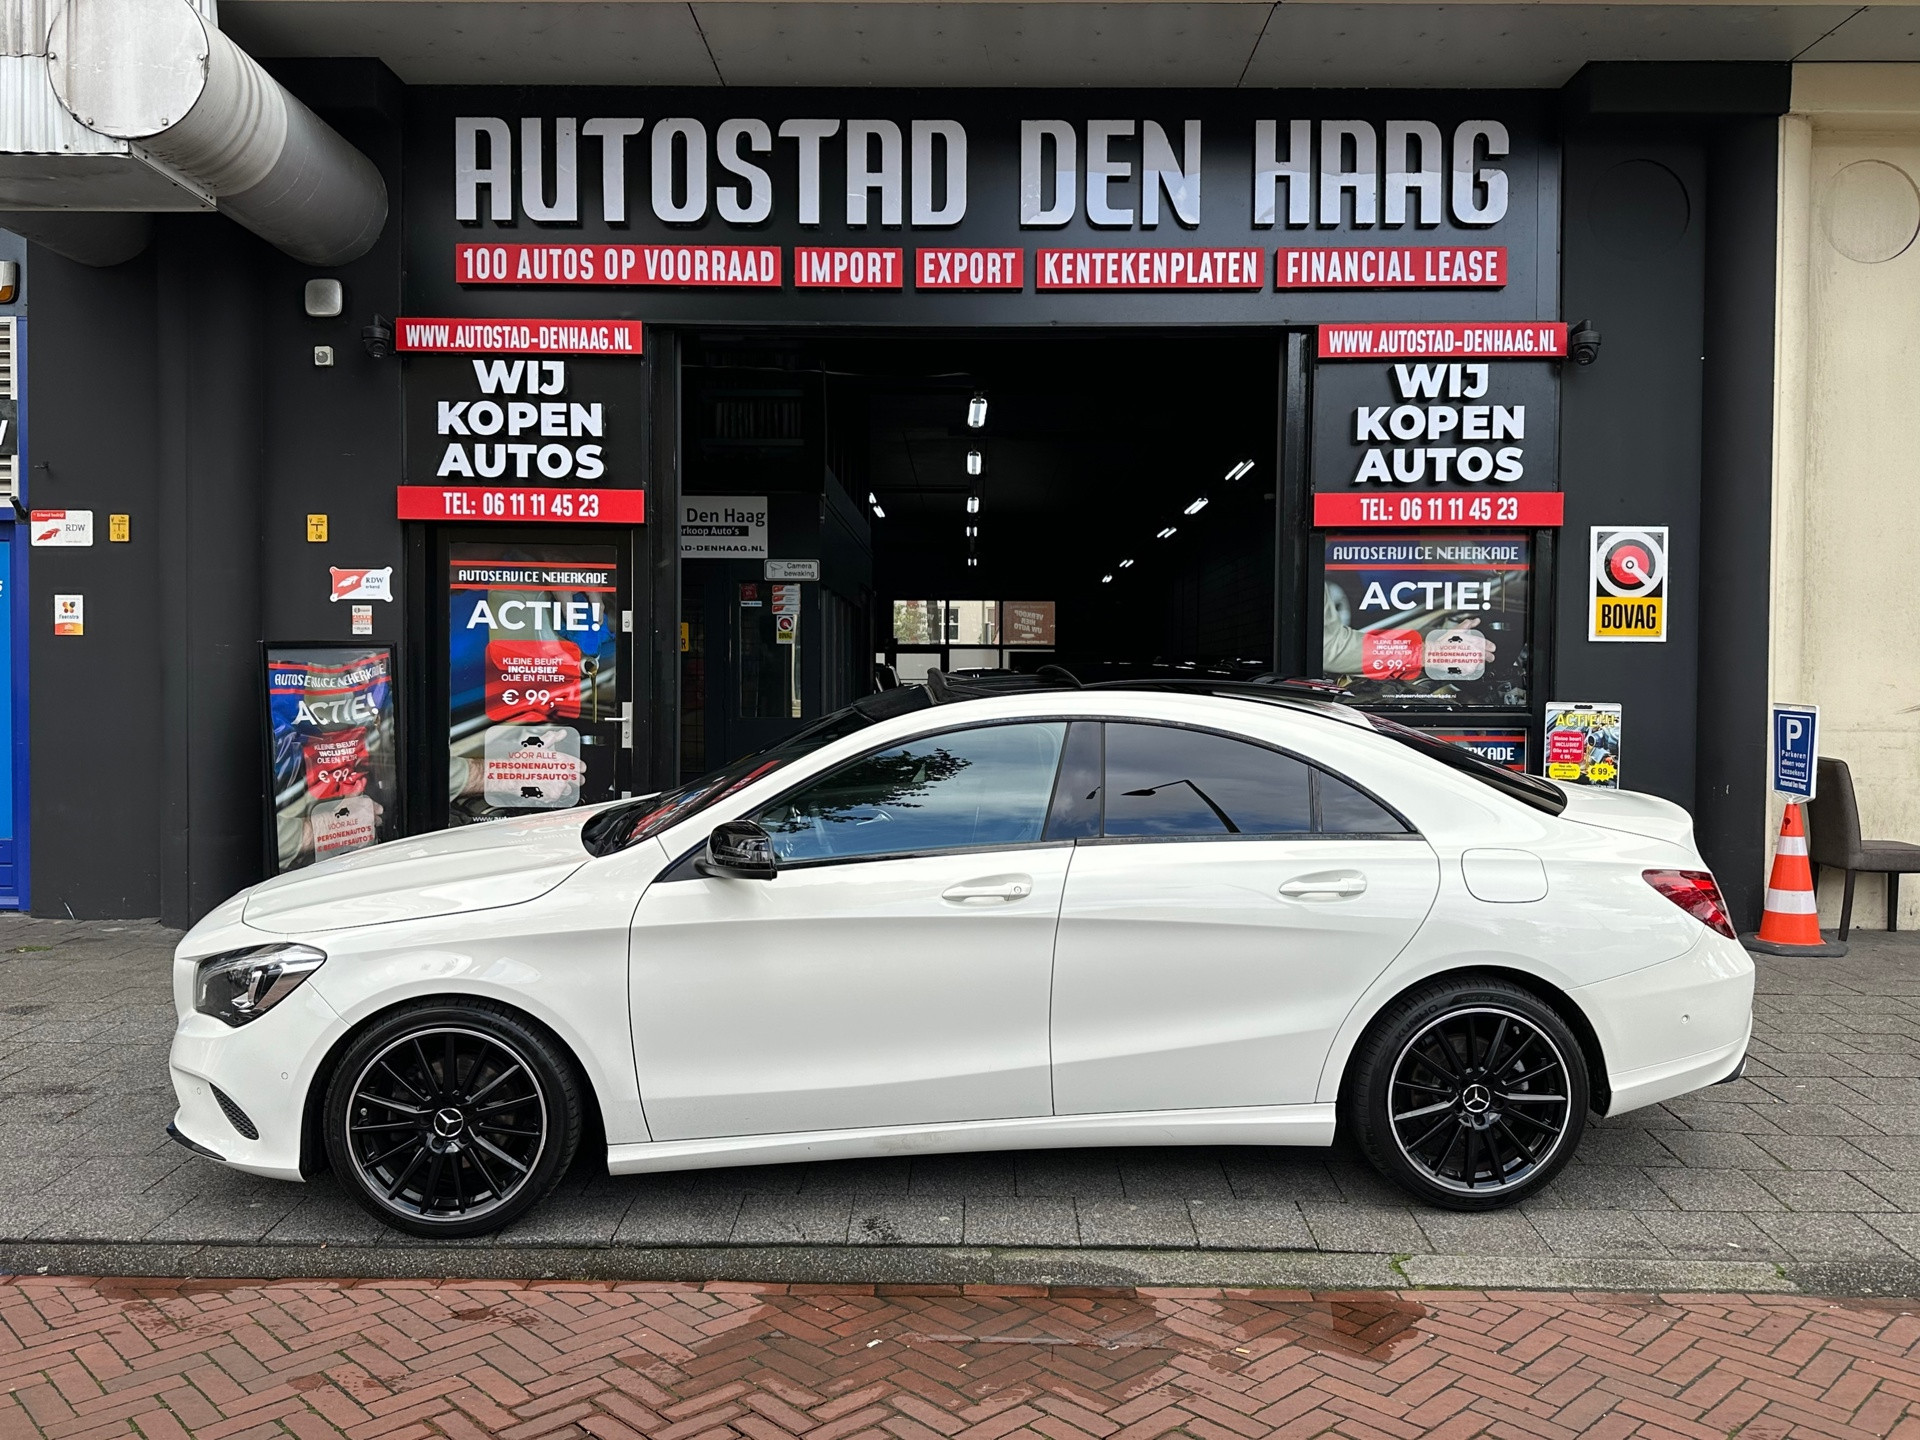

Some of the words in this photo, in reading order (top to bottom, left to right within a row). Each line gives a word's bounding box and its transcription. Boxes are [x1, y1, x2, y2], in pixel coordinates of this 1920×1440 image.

[455, 117, 967, 225] AUTOSTAD
[1020, 119, 1202, 225] DEN
[1254, 119, 1510, 225] HAAG
[463, 248, 507, 280] 100
[517, 248, 595, 281] AUTOS
[604, 249, 635, 281] OP
[644, 249, 775, 282] VOORRAAD
[801, 251, 896, 283] IMPORT
[923, 251, 1016, 284] EXPORT
[1044, 251, 1258, 285] KENTEKENPLATEN
[1287, 250, 1415, 283] FINANCIAL
[1425, 250, 1498, 282] LEASE
[406, 324, 632, 350] WWW.AUTOSTAD-DENHAAG.NL
[1328, 329, 1557, 353] WWW.AUTOSTAD-DENHAAG.NL
[472, 359, 565, 395] WIJ
[1394, 363, 1489, 398] WIJ
[437, 400, 604, 437] KOPEN
[1356, 404, 1525, 441] KOPEN
[436, 443, 605, 480] AUTOS
[1354, 446, 1524, 483] AUTOS
[443, 492, 476, 515] TEL:
[482, 492, 505, 516] 06
[510, 493, 525, 516] 11
[530, 494, 545, 516] 11
[551, 494, 573, 517] 45
[578, 494, 600, 518] 23
[1360, 498, 1393, 521] TEL:
[1400, 498, 1422, 521] 06
[1427, 498, 1442, 520] 11
[1448, 498, 1463, 520] 11
[1469, 498, 1492, 520] 45
[1497, 497, 1518, 520] 23
[65, 524, 86, 532] RDW
[686, 508, 719, 523] Den
[724, 508, 766, 527] Haag
[681, 527, 709, 537] rkoop
[710, 527, 740, 536] Auto's
[1333, 546, 1433, 560] AUTOSERVICE
[1436, 546, 1519, 560] NEHERKADE
[458, 570, 540, 583] AUTOSERVICE
[542, 571, 608, 584] NEHERKADE
[1358, 581, 1492, 611] ACTIE!
[466, 600, 601, 632] ACTIE!
[1601, 603, 1657, 630] BOVAG
[502, 657, 533, 666] KLEINE
[534, 657, 564, 666] BEURT
[508, 666, 558, 674] INCLUSIEF
[1372, 660, 1384, 670] €
[1386, 660, 1412, 671] 99,-
[501, 674, 522, 682] OLIE
[523, 674, 536, 682] EN
[536, 674, 565, 682] FILTER
[291, 692, 379, 726] ACTIE!
[502, 690, 519, 706] €
[525, 690, 564, 708] 99,-
[336, 740, 359, 749] BEURT
[1786, 718, 1802, 750] P
[319, 748, 356, 757] INCLUSIEF
[331, 756, 341, 764] EN
[1782, 750, 1806, 760] Parkeren
[318, 770, 331, 784] €
[332, 768, 358, 783] 99,-
[1598, 768, 1614, 776] 99,-
[1782, 768, 1805, 778] bezoekers
[316, 826, 372, 842] PERSONENAUTO'S
[328, 820, 346, 830] VOOR
[346, 818, 359, 827] ALLE
